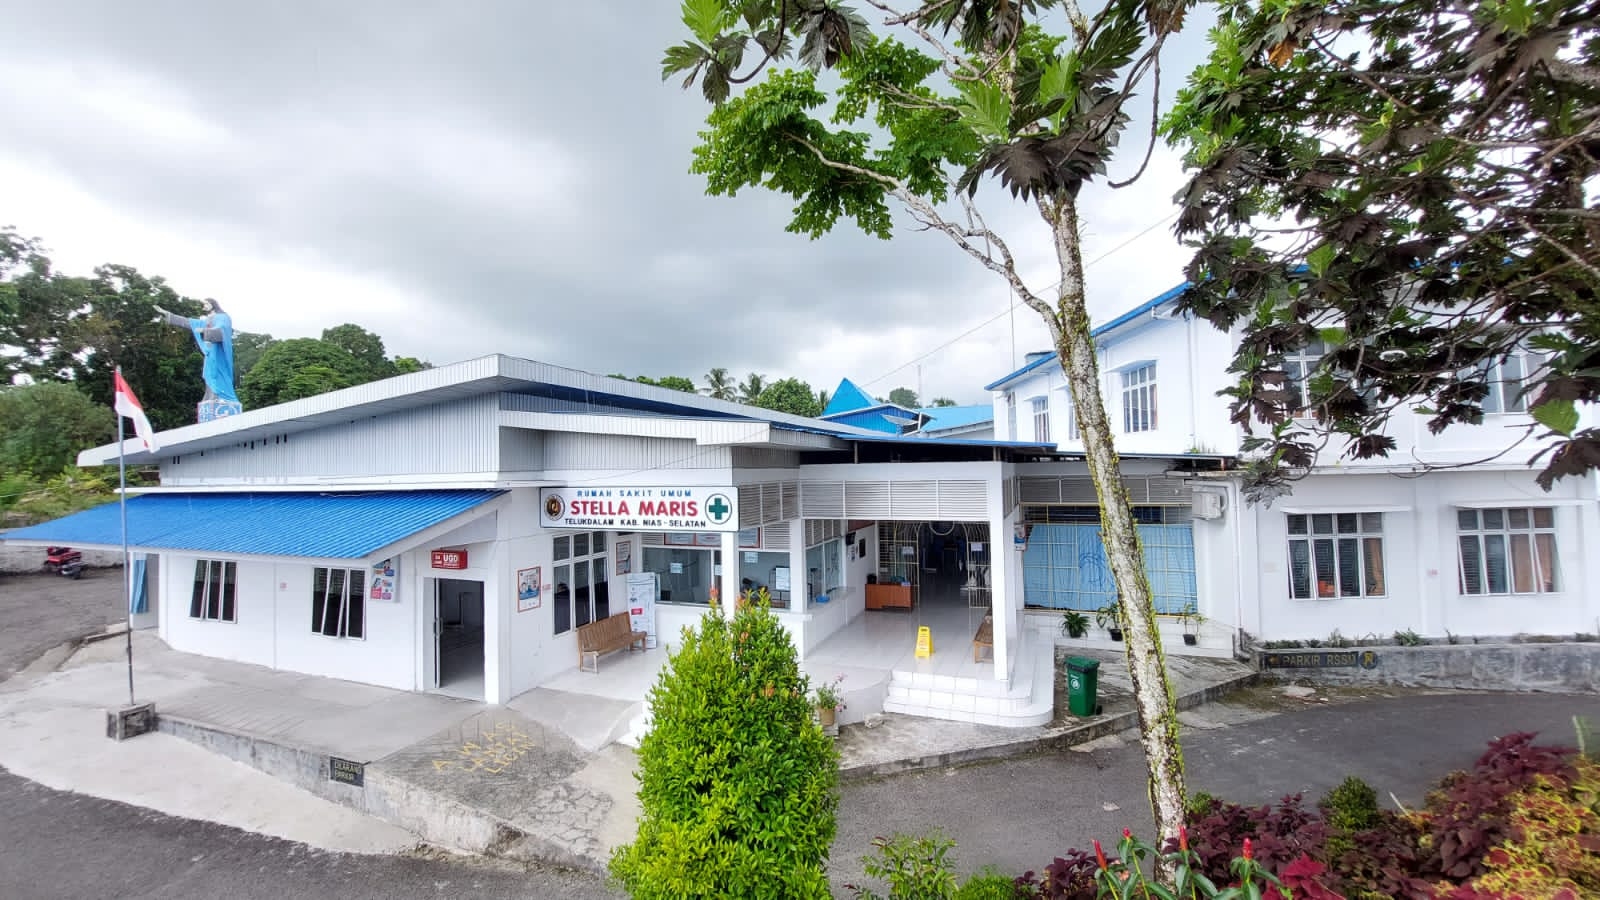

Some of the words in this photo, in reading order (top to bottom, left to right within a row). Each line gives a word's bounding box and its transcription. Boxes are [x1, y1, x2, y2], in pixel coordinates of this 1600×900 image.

[570, 500, 630, 516] STELLA
[638, 501, 698, 517] MARIS
[565, 518, 614, 526] TELUKDALAM
[1283, 655, 1320, 665] PARKIR
